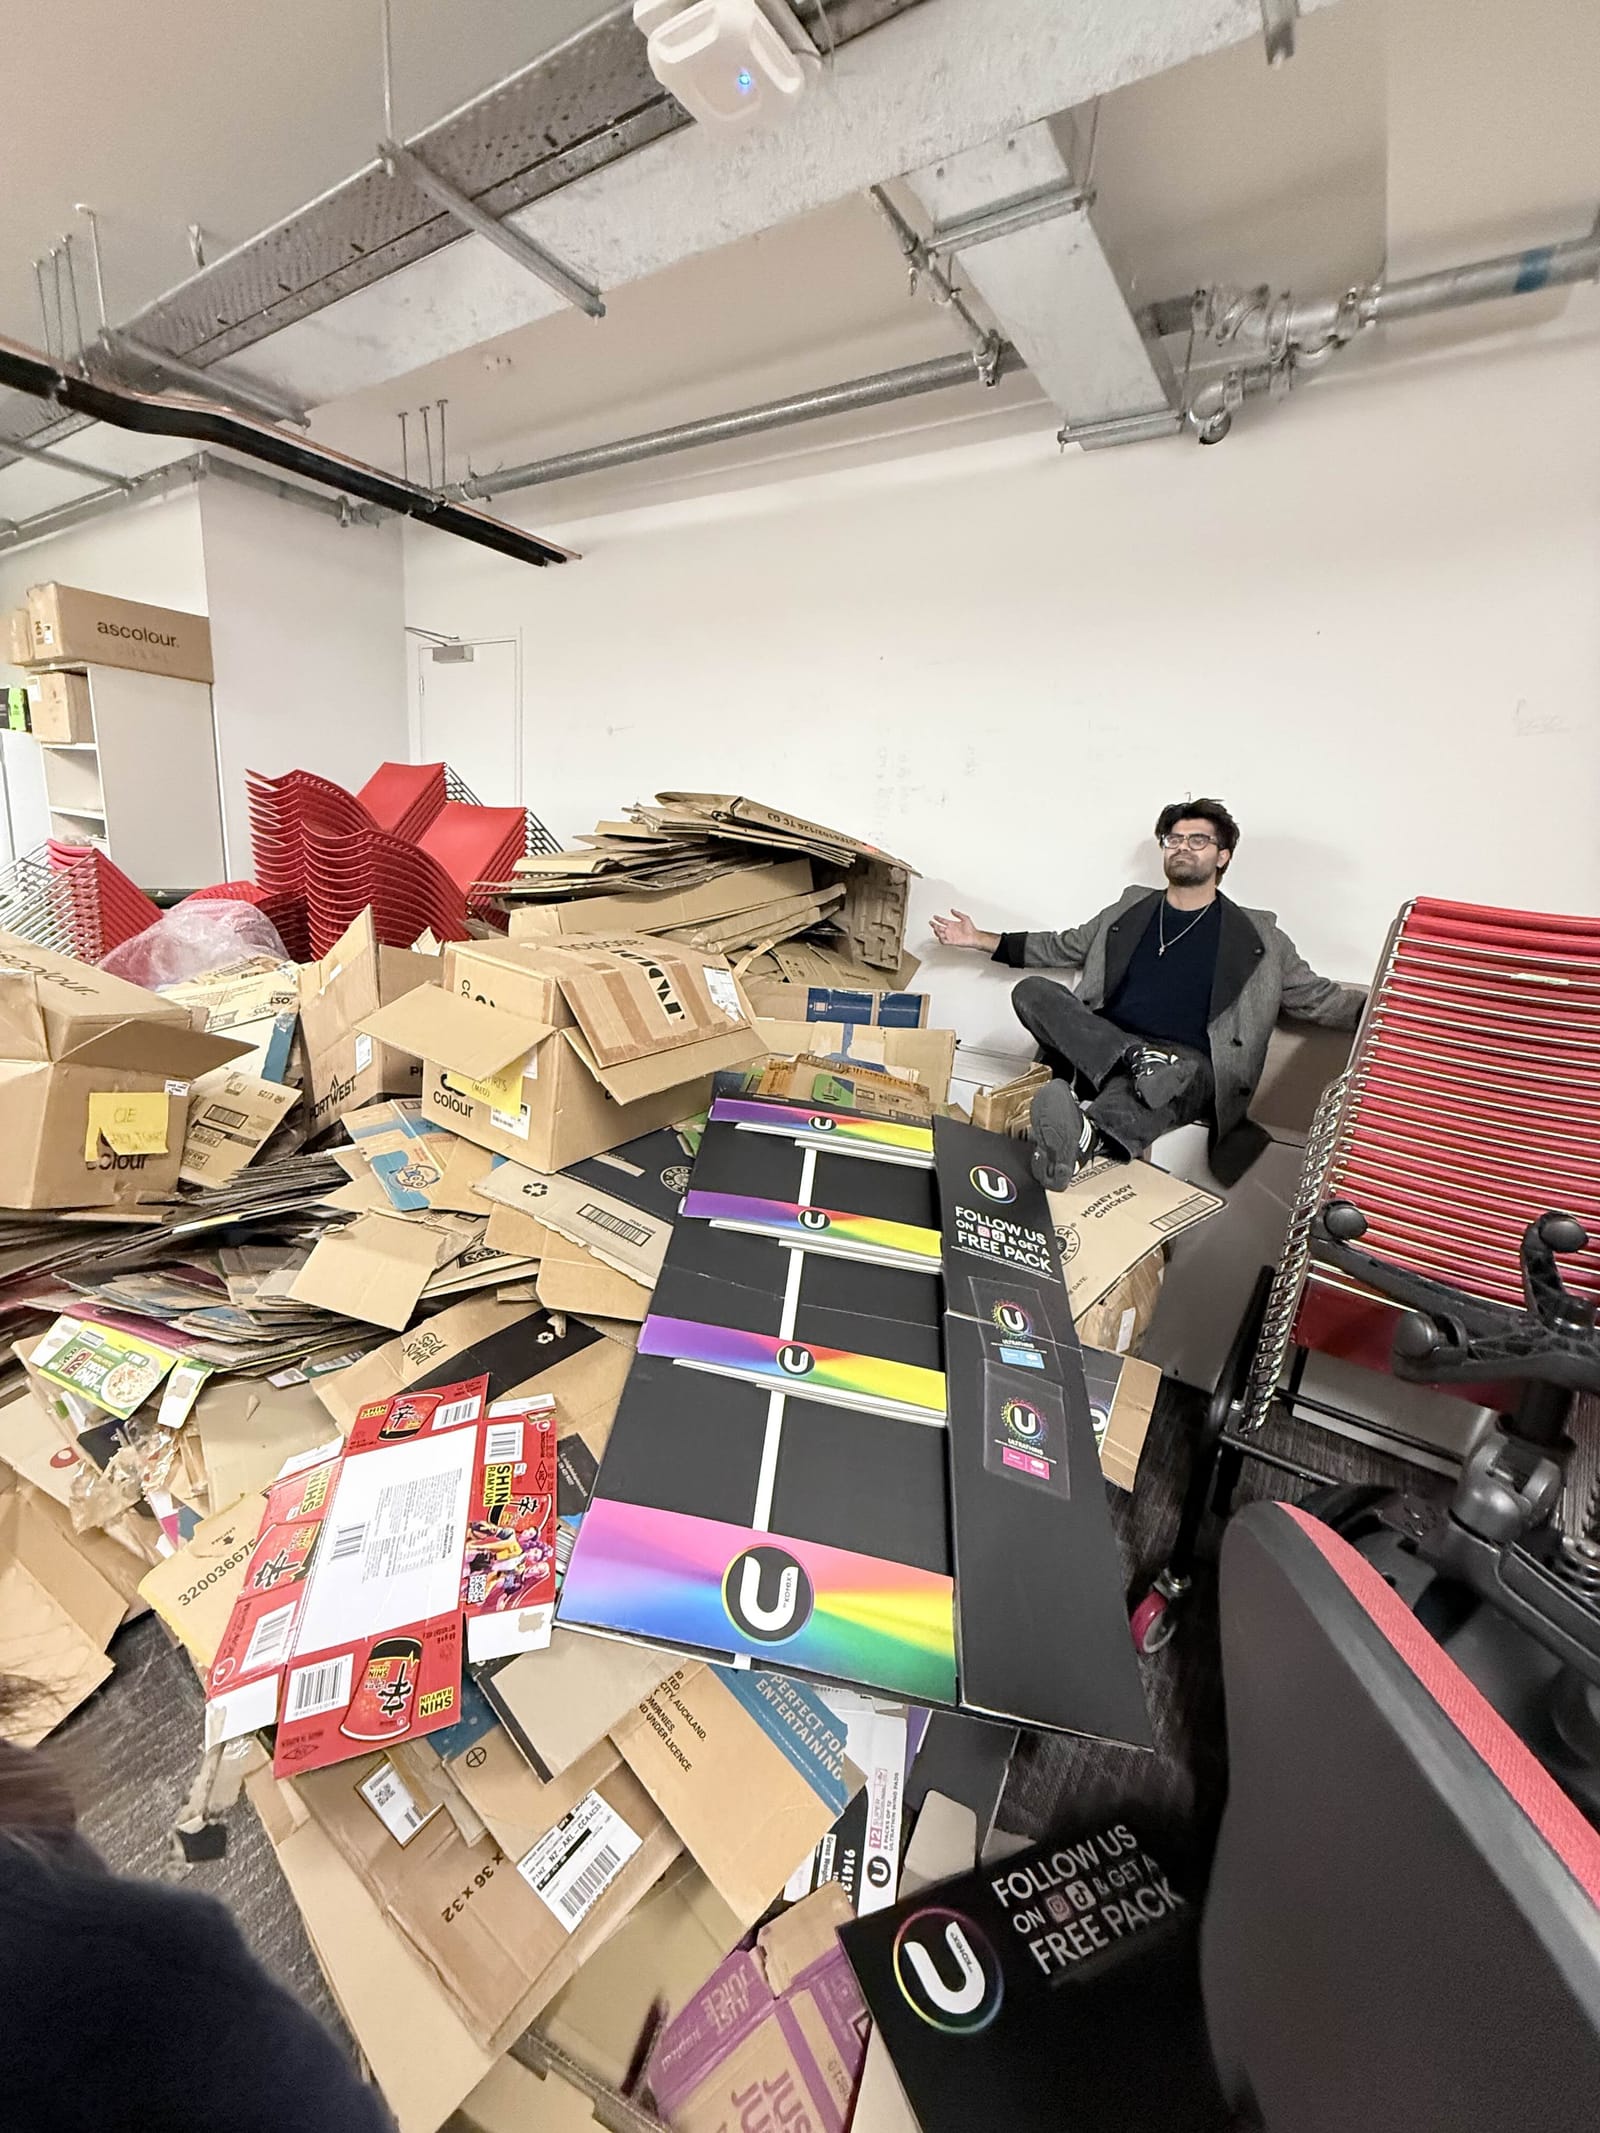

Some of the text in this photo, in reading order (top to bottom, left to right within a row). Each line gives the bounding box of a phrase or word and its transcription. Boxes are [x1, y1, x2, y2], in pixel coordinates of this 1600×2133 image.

[433, 1090, 473, 1120] colour
[1081, 1184, 1133, 1218] HONEY SOY
[1094, 1192, 1137, 1219] CHICKEN
[955, 1206, 1047, 1245] FOLLOW US
[956, 1220, 1050, 1256] ON & GET A
[957, 1231, 1003, 1255] FREE
[1004, 1244, 1053, 1273] PACK
[486, 1466, 497, 1506] RAMYUN
[497, 1464, 510, 1505] SHIN
[419, 1696, 453, 1716] SHIN
[772, 1672, 823, 1729] PERFECT
[646, 1713, 670, 1742] UNDER
[664, 1736, 693, 1773] LICENCE
[755, 1679, 842, 1781] ENTERTAINING
[869, 1828, 881, 1849] 12
[992, 1825, 1137, 1908] FOLLOW US
[441, 1898, 465, 1923] 32
[1013, 1907, 1043, 1934] ON
[1028, 1877, 1186, 1976] FREE PACK
